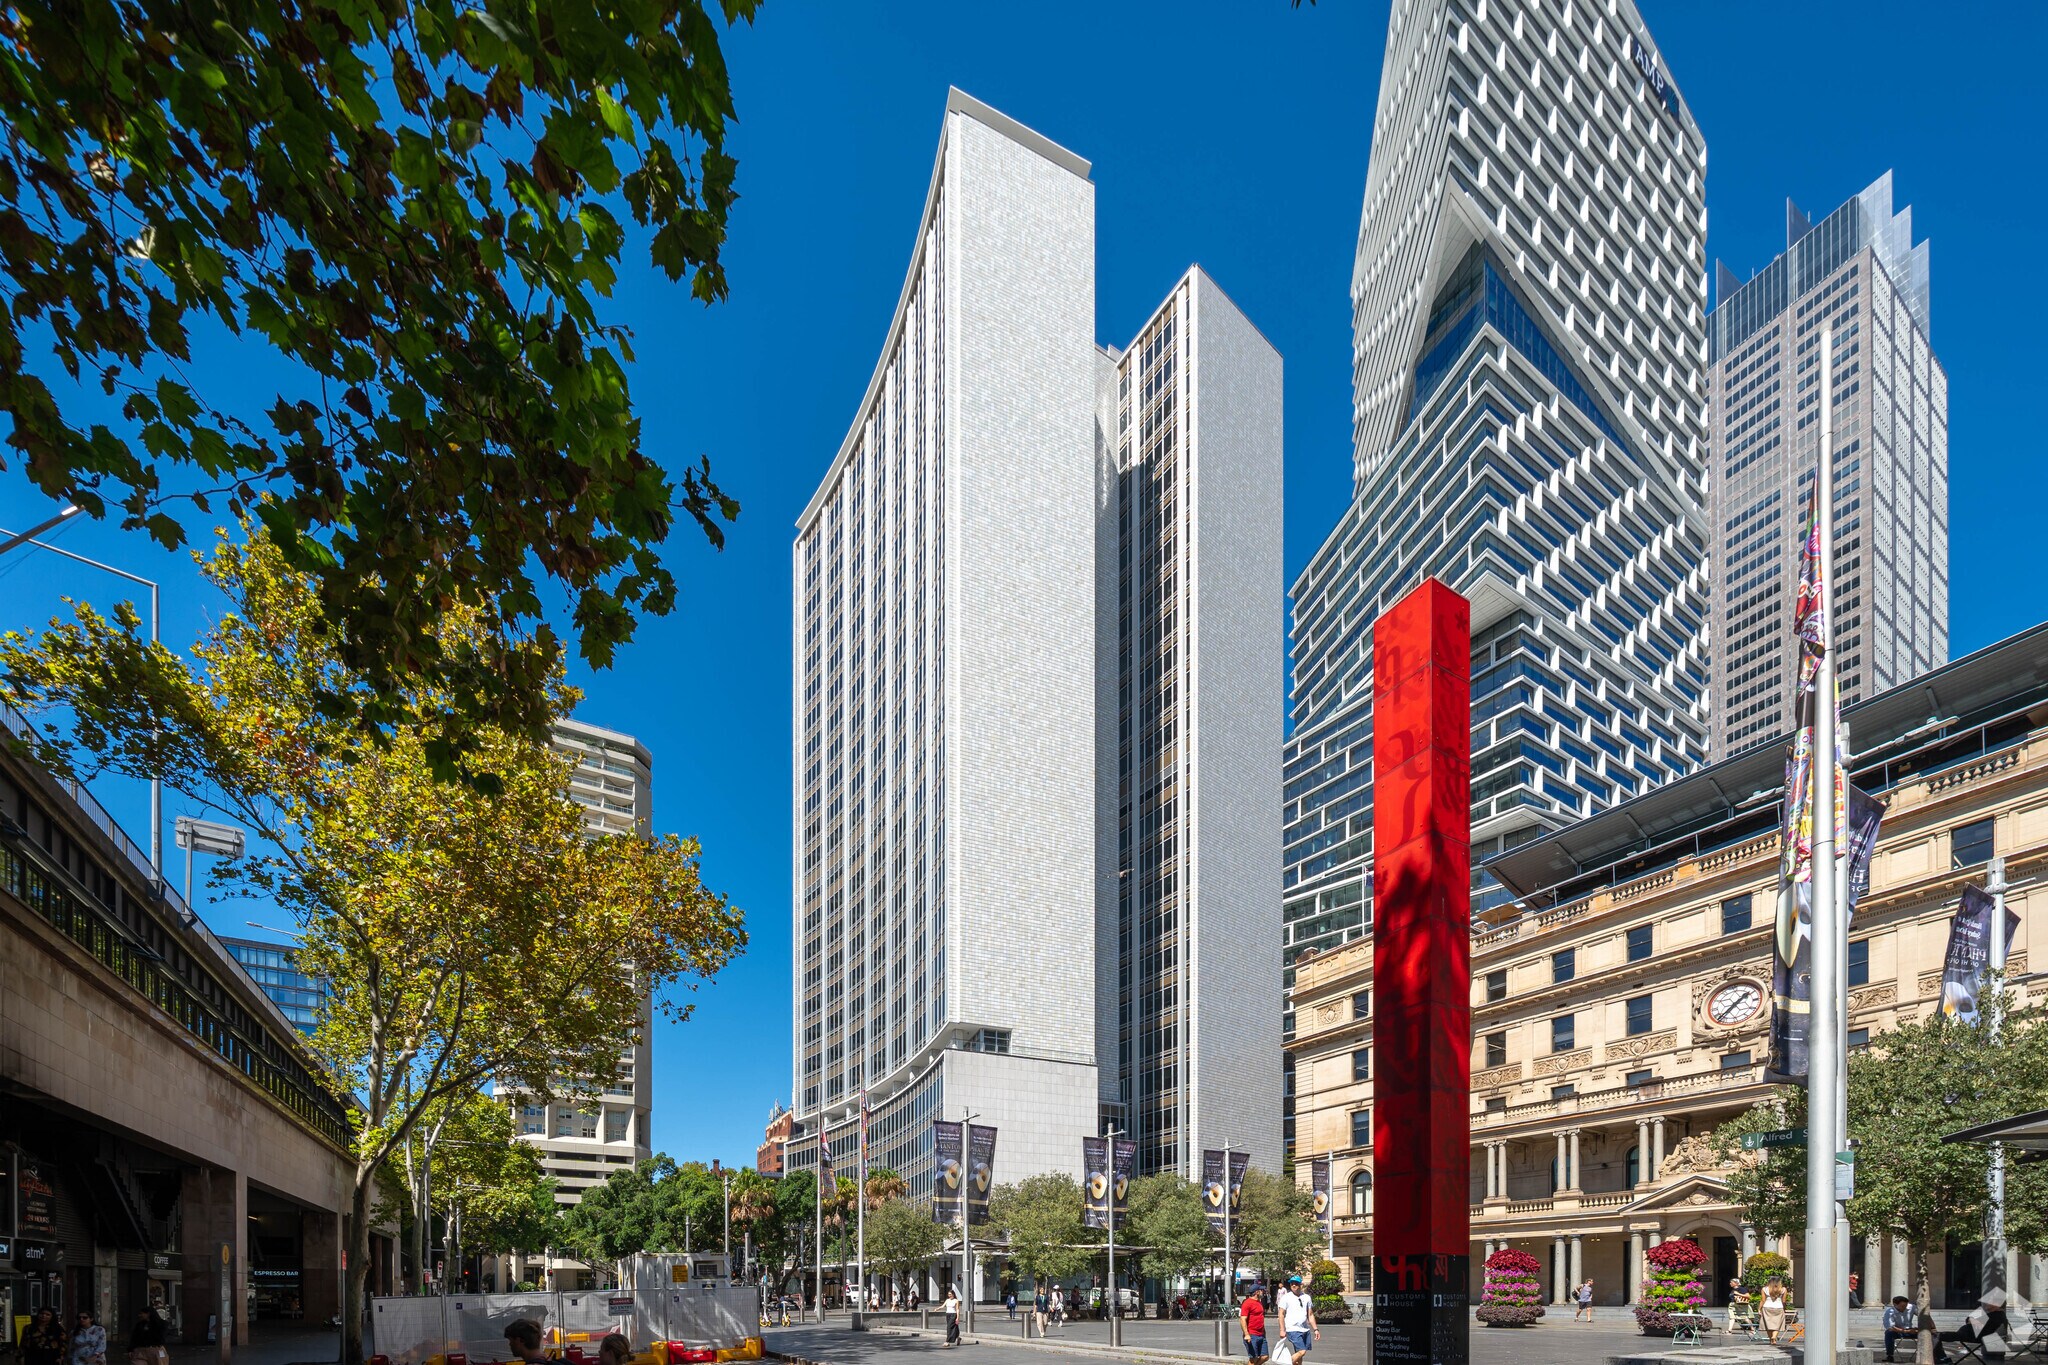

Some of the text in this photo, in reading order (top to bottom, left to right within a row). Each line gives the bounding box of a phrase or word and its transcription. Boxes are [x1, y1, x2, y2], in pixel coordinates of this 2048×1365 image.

[1635, 43, 1664, 94] AMP
[1760, 1131, 1793, 1143] Alfred
[154, 1256, 169, 1265] COFFEE
[1376, 1318, 1394, 1326] Library
[1376, 1326, 1390, 1334] Quay
[1376, 1334, 1392, 1342] Young
[1390, 1343, 1410, 1351] Sydney
[1395, 1351, 1409, 1359] Long
